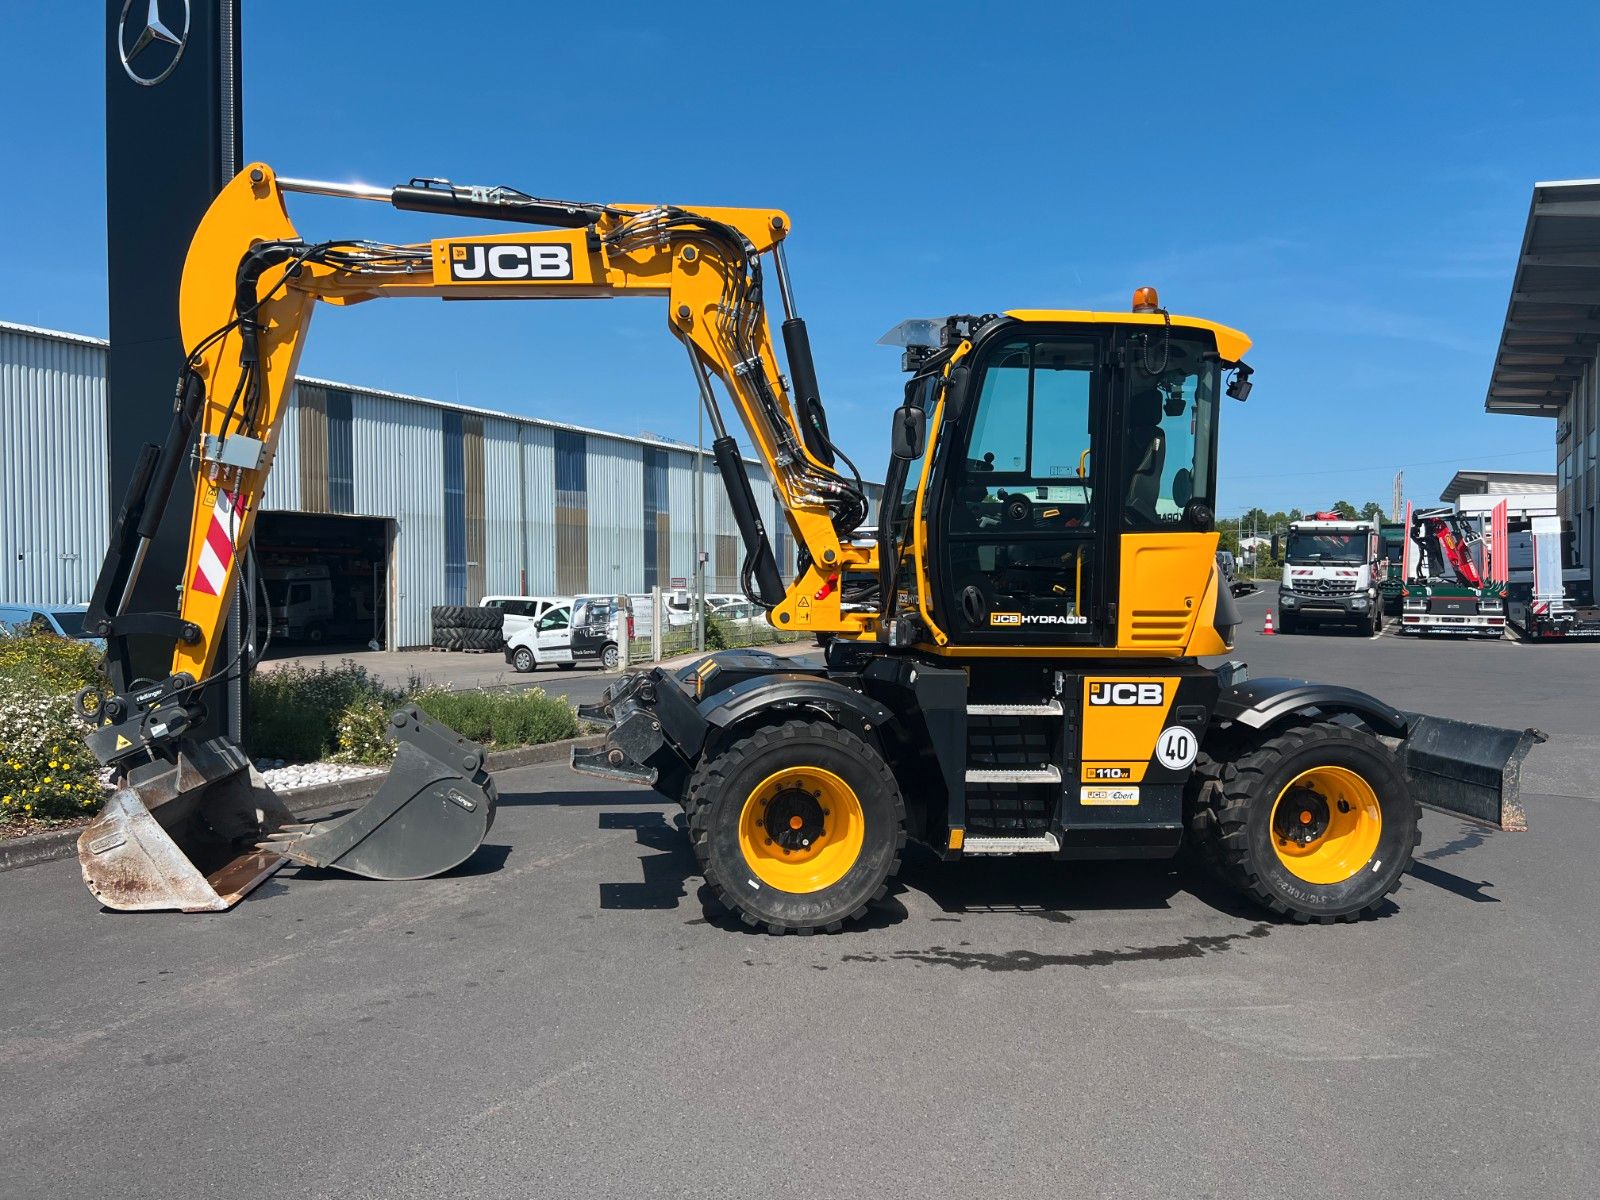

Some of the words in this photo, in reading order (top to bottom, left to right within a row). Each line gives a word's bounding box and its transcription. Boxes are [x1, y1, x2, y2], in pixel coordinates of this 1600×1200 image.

[453, 245, 571, 279] JCB
[993, 615, 1019, 623] JCB
[1021, 615, 1088, 624] HYDRADIG
[1090, 683, 1163, 705] JCB
[1165, 735, 1188, 760] 40
